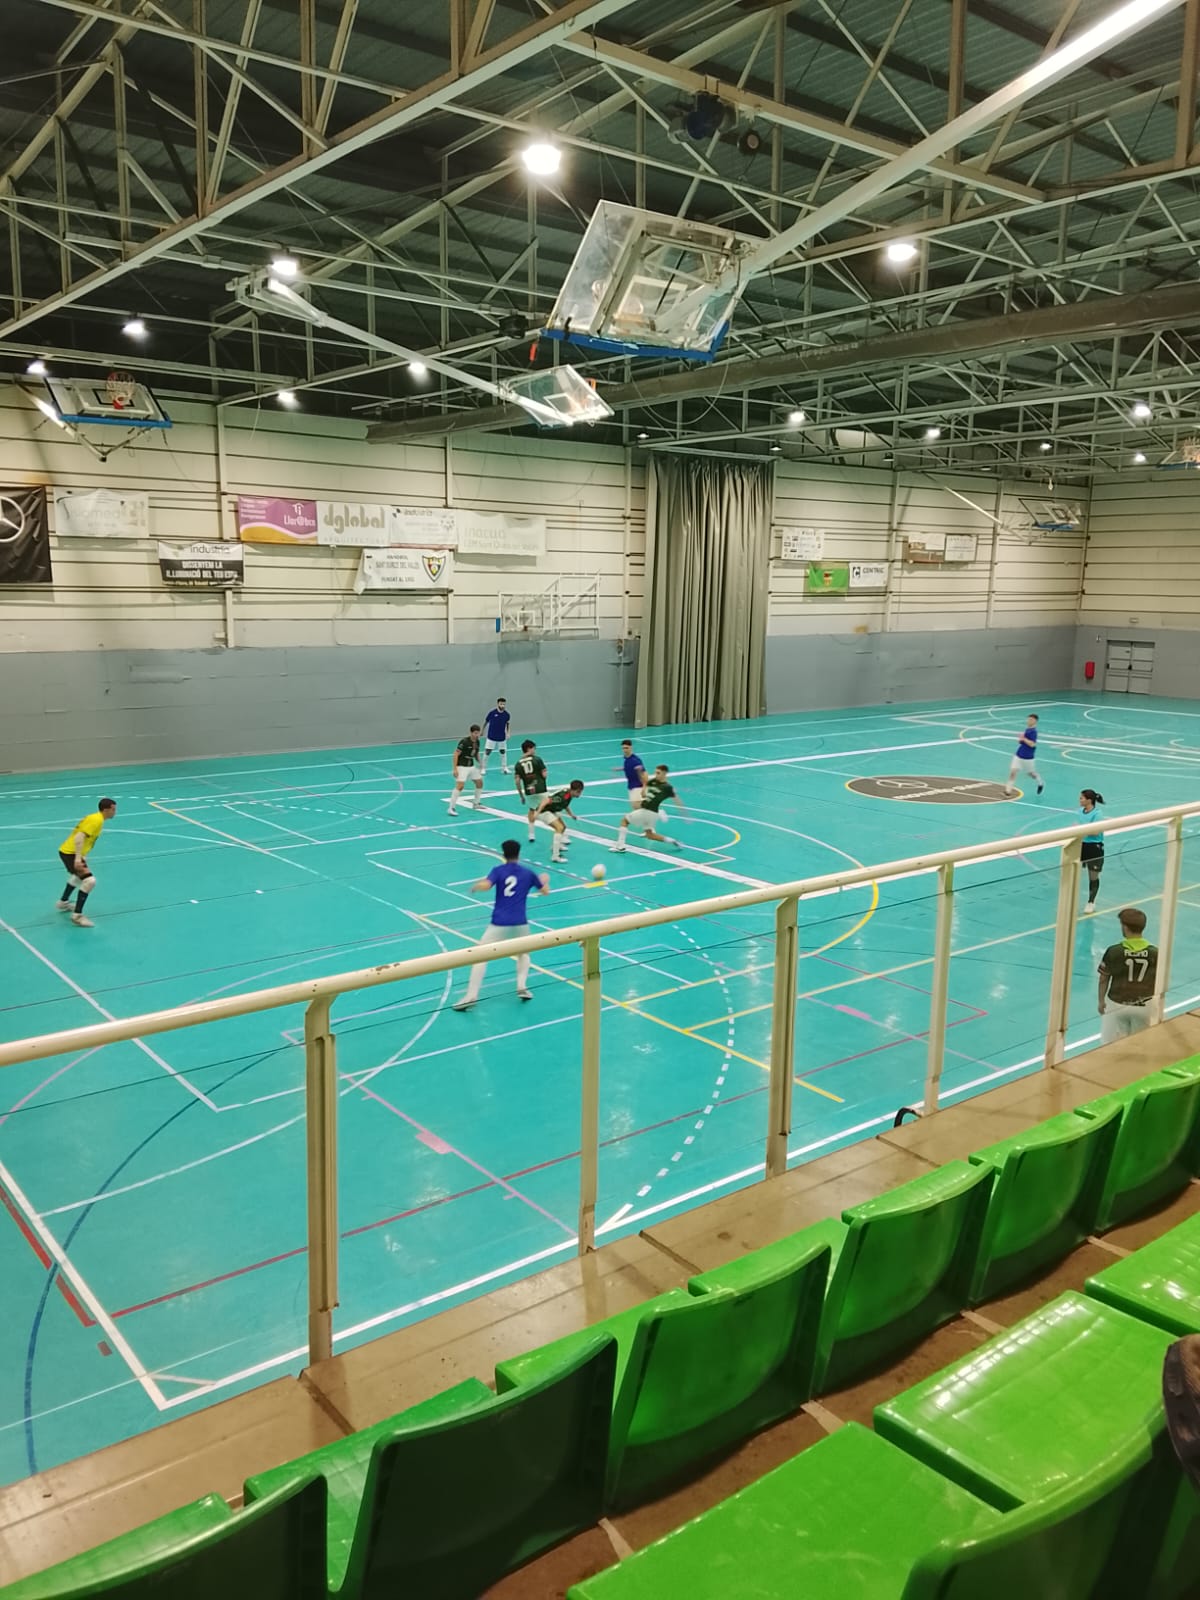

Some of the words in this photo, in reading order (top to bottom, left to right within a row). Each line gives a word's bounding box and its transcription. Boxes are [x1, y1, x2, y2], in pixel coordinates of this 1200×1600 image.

[323, 503, 385, 534] dglobal
[202, 570, 213, 578] DEL
[215, 561, 223, 569] LA
[522, 760, 534, 774] 10
[503, 875, 518, 897] 2
[1125, 958, 1149, 982] 17
